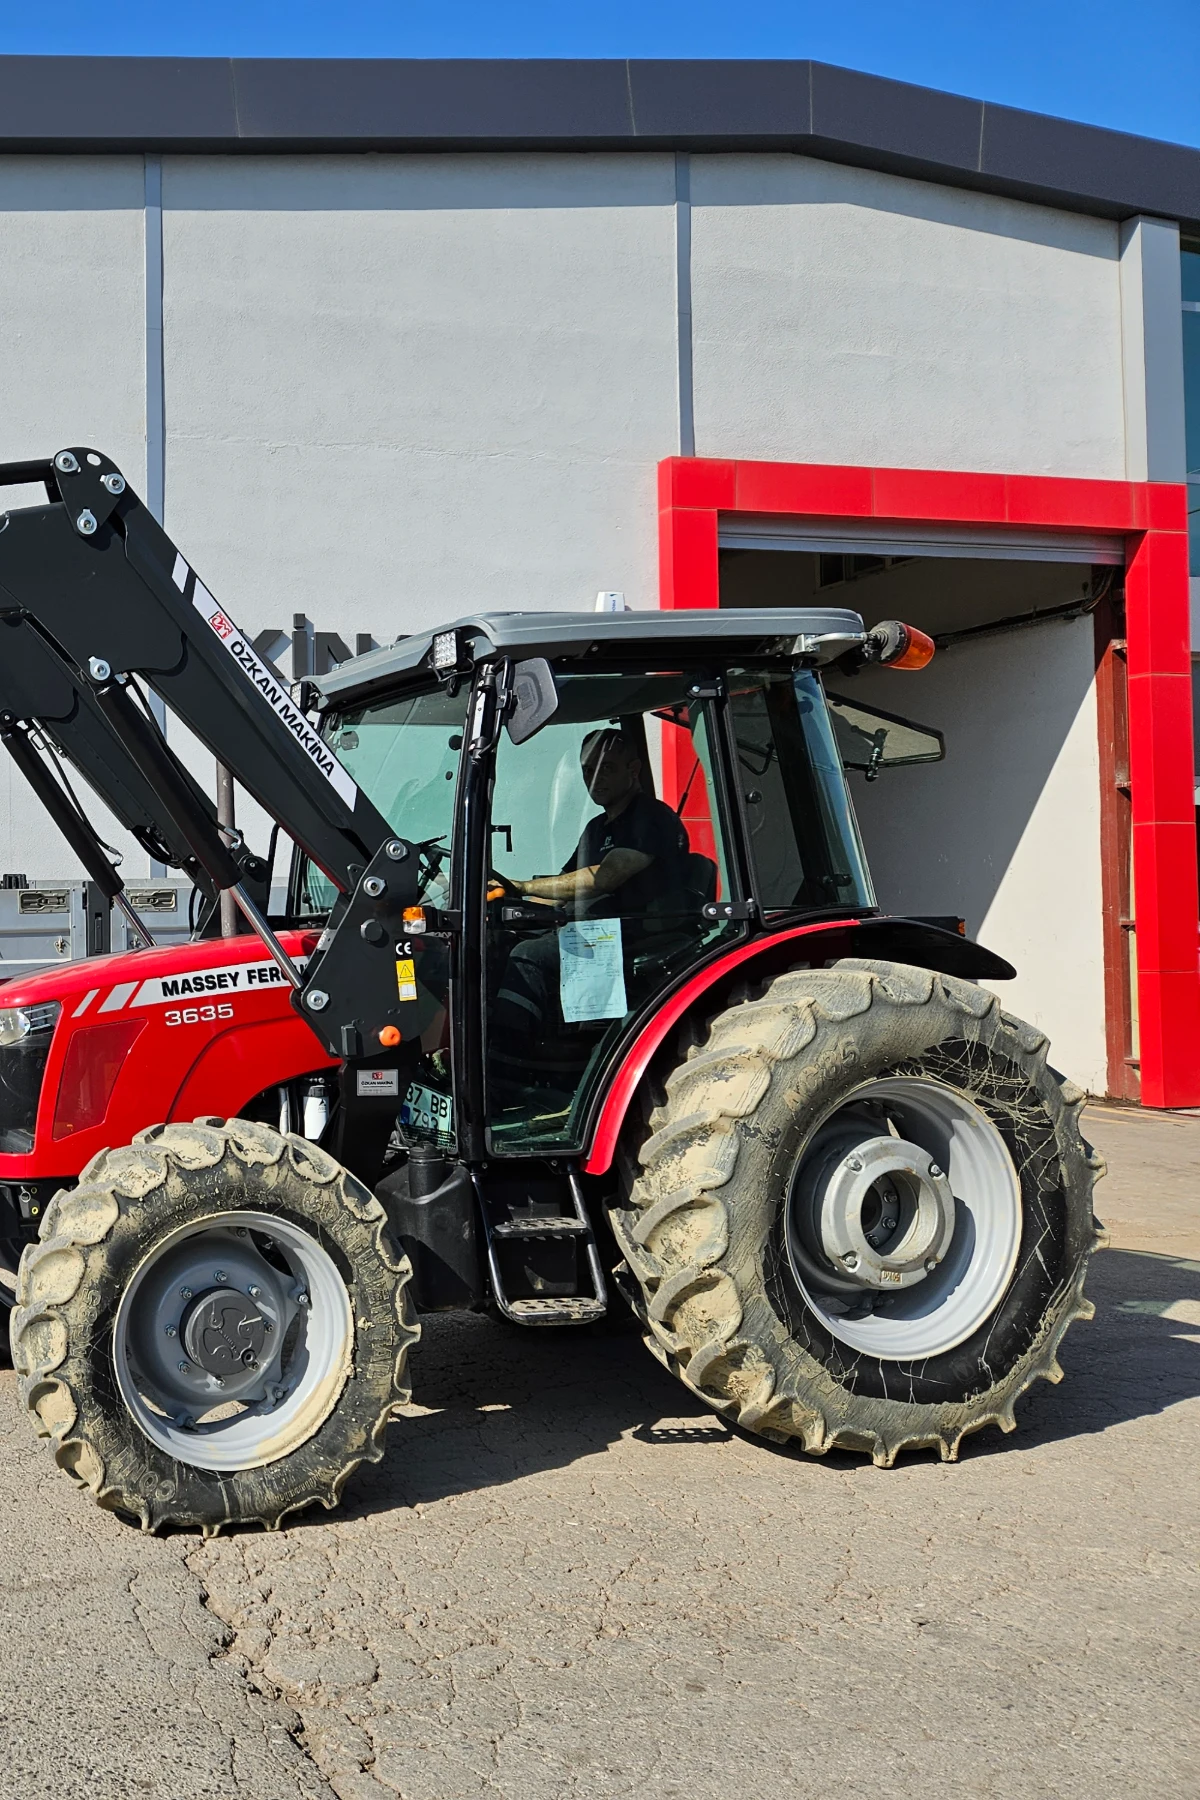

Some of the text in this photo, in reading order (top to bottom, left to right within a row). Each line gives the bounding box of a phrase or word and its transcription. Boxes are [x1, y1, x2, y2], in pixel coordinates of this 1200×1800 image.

[230, 640, 335, 777] ÖZKAN MAKİNA
[161, 971, 240, 997] MASSEY
[164, 1003, 234, 1026] 3635
[405, 1085, 448, 1118] 37 BB
